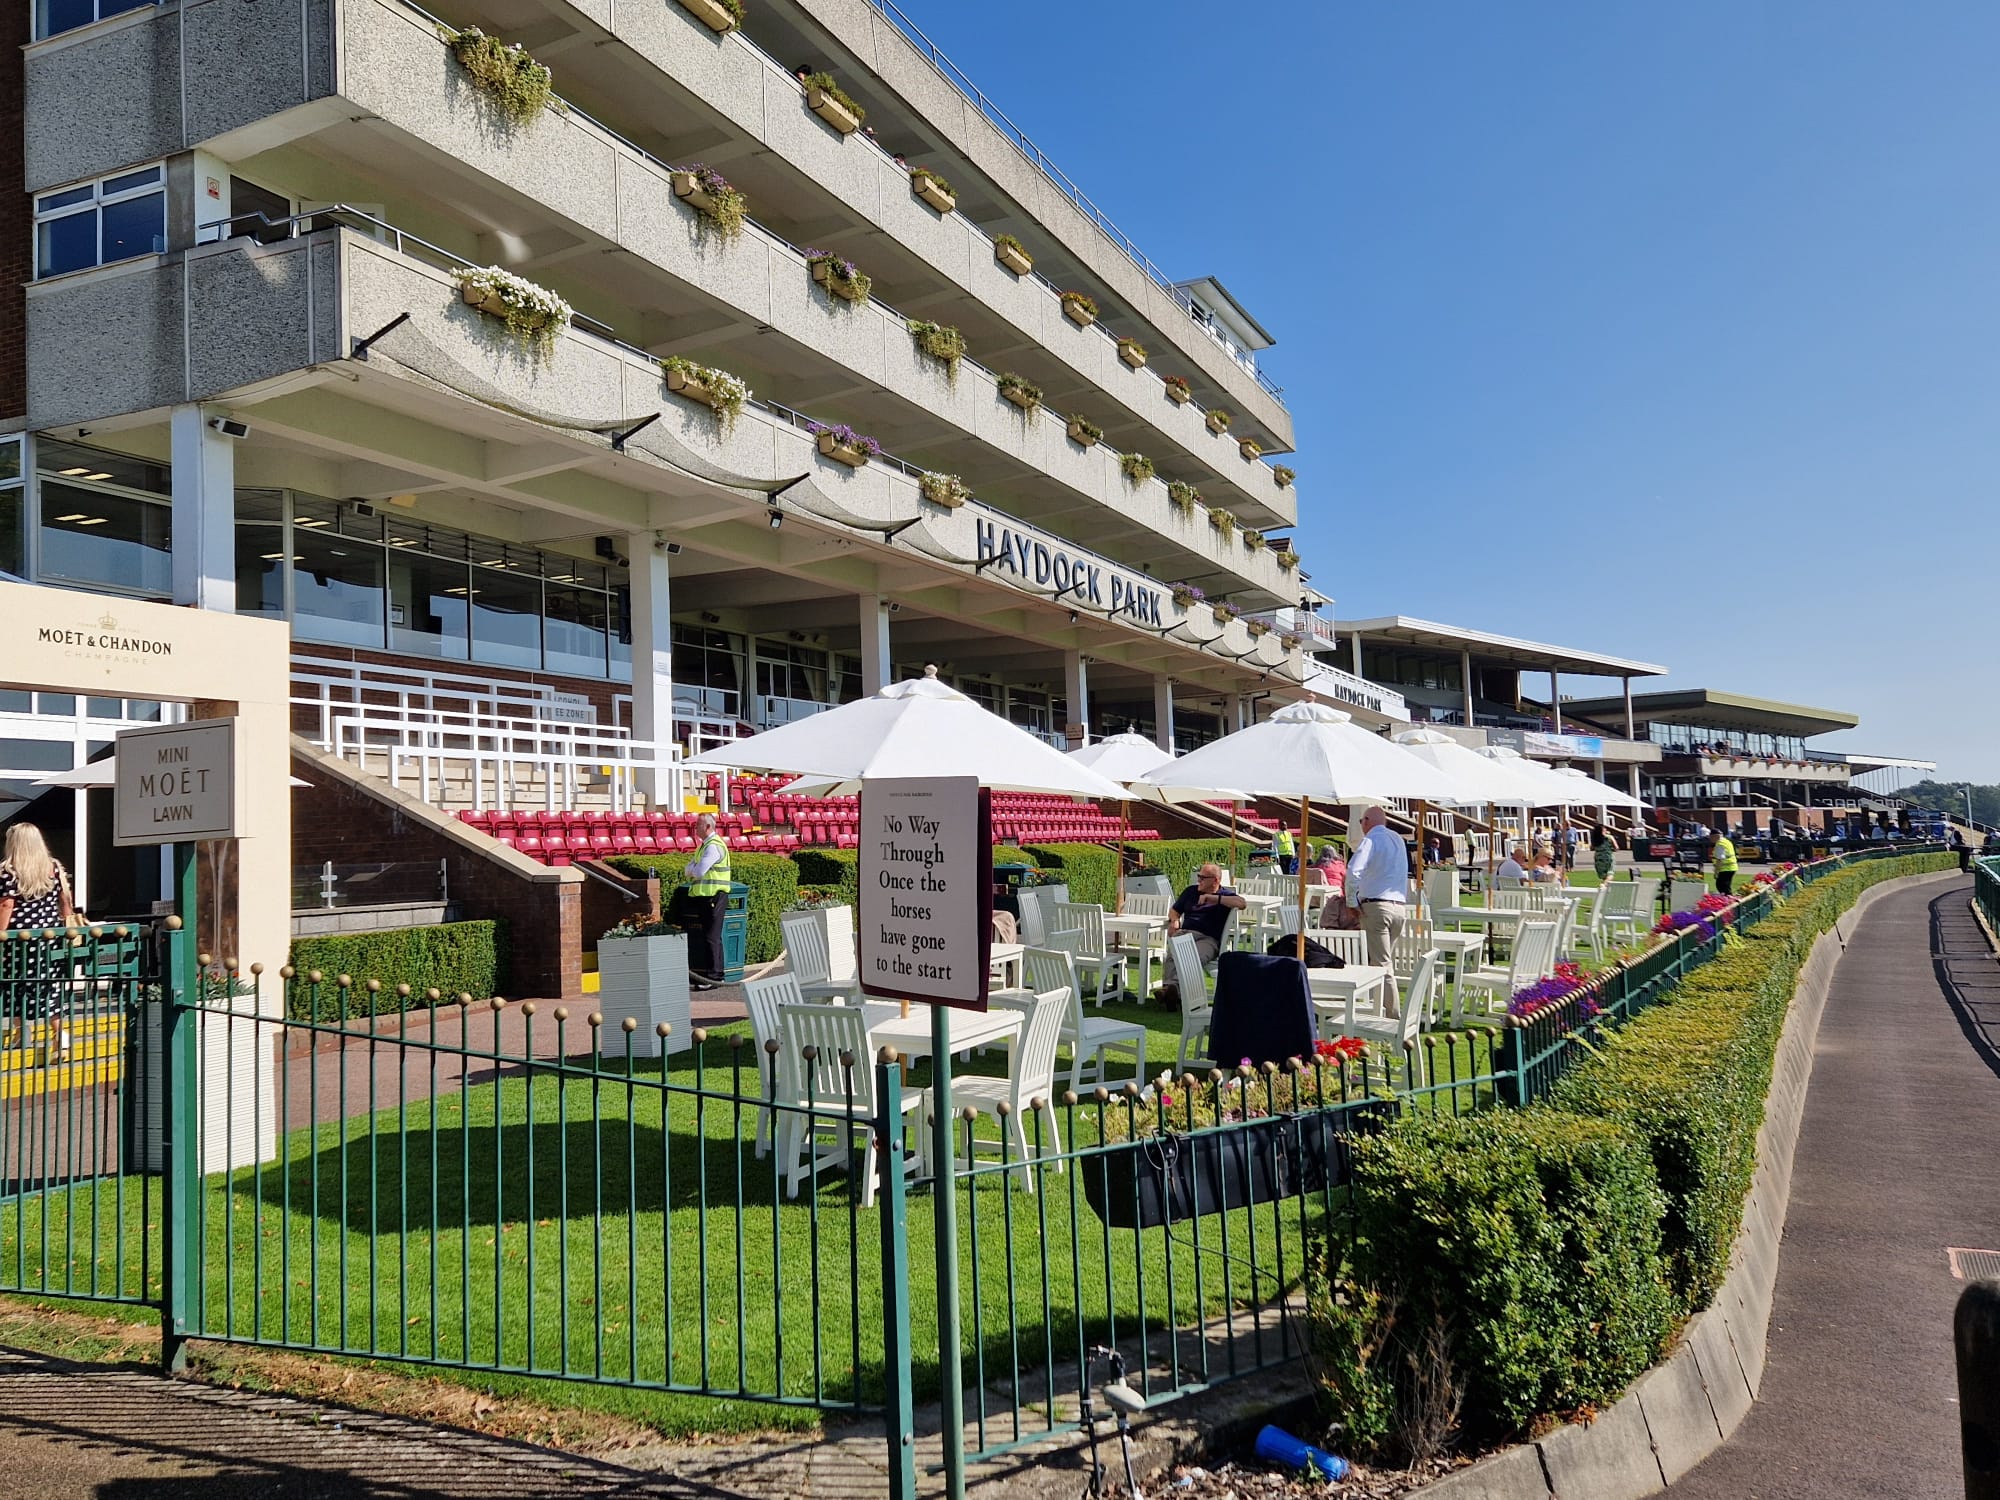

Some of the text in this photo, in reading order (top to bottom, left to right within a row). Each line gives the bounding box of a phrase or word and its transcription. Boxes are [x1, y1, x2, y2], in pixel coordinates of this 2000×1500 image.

[977, 518, 1161, 627] HAYDOCK PARK
[38, 628, 172, 655] MOËT & CHANDON
[64, 650, 149, 665] CHAMPAGNE
[1334, 683, 1382, 712] HAYDOCK PARK
[566, 709, 584, 718] ZONE
[158, 746, 189, 763] MINI
[139, 767, 210, 798] MOËT
[153, 805, 193, 823] LAWN
[883, 815, 940, 840] No Way
[880, 842, 944, 868] Through
[879, 870, 946, 892] Once the
[891, 897, 931, 920] horses
[880, 925, 945, 954] have gone
[876, 954, 952, 980] to the start
